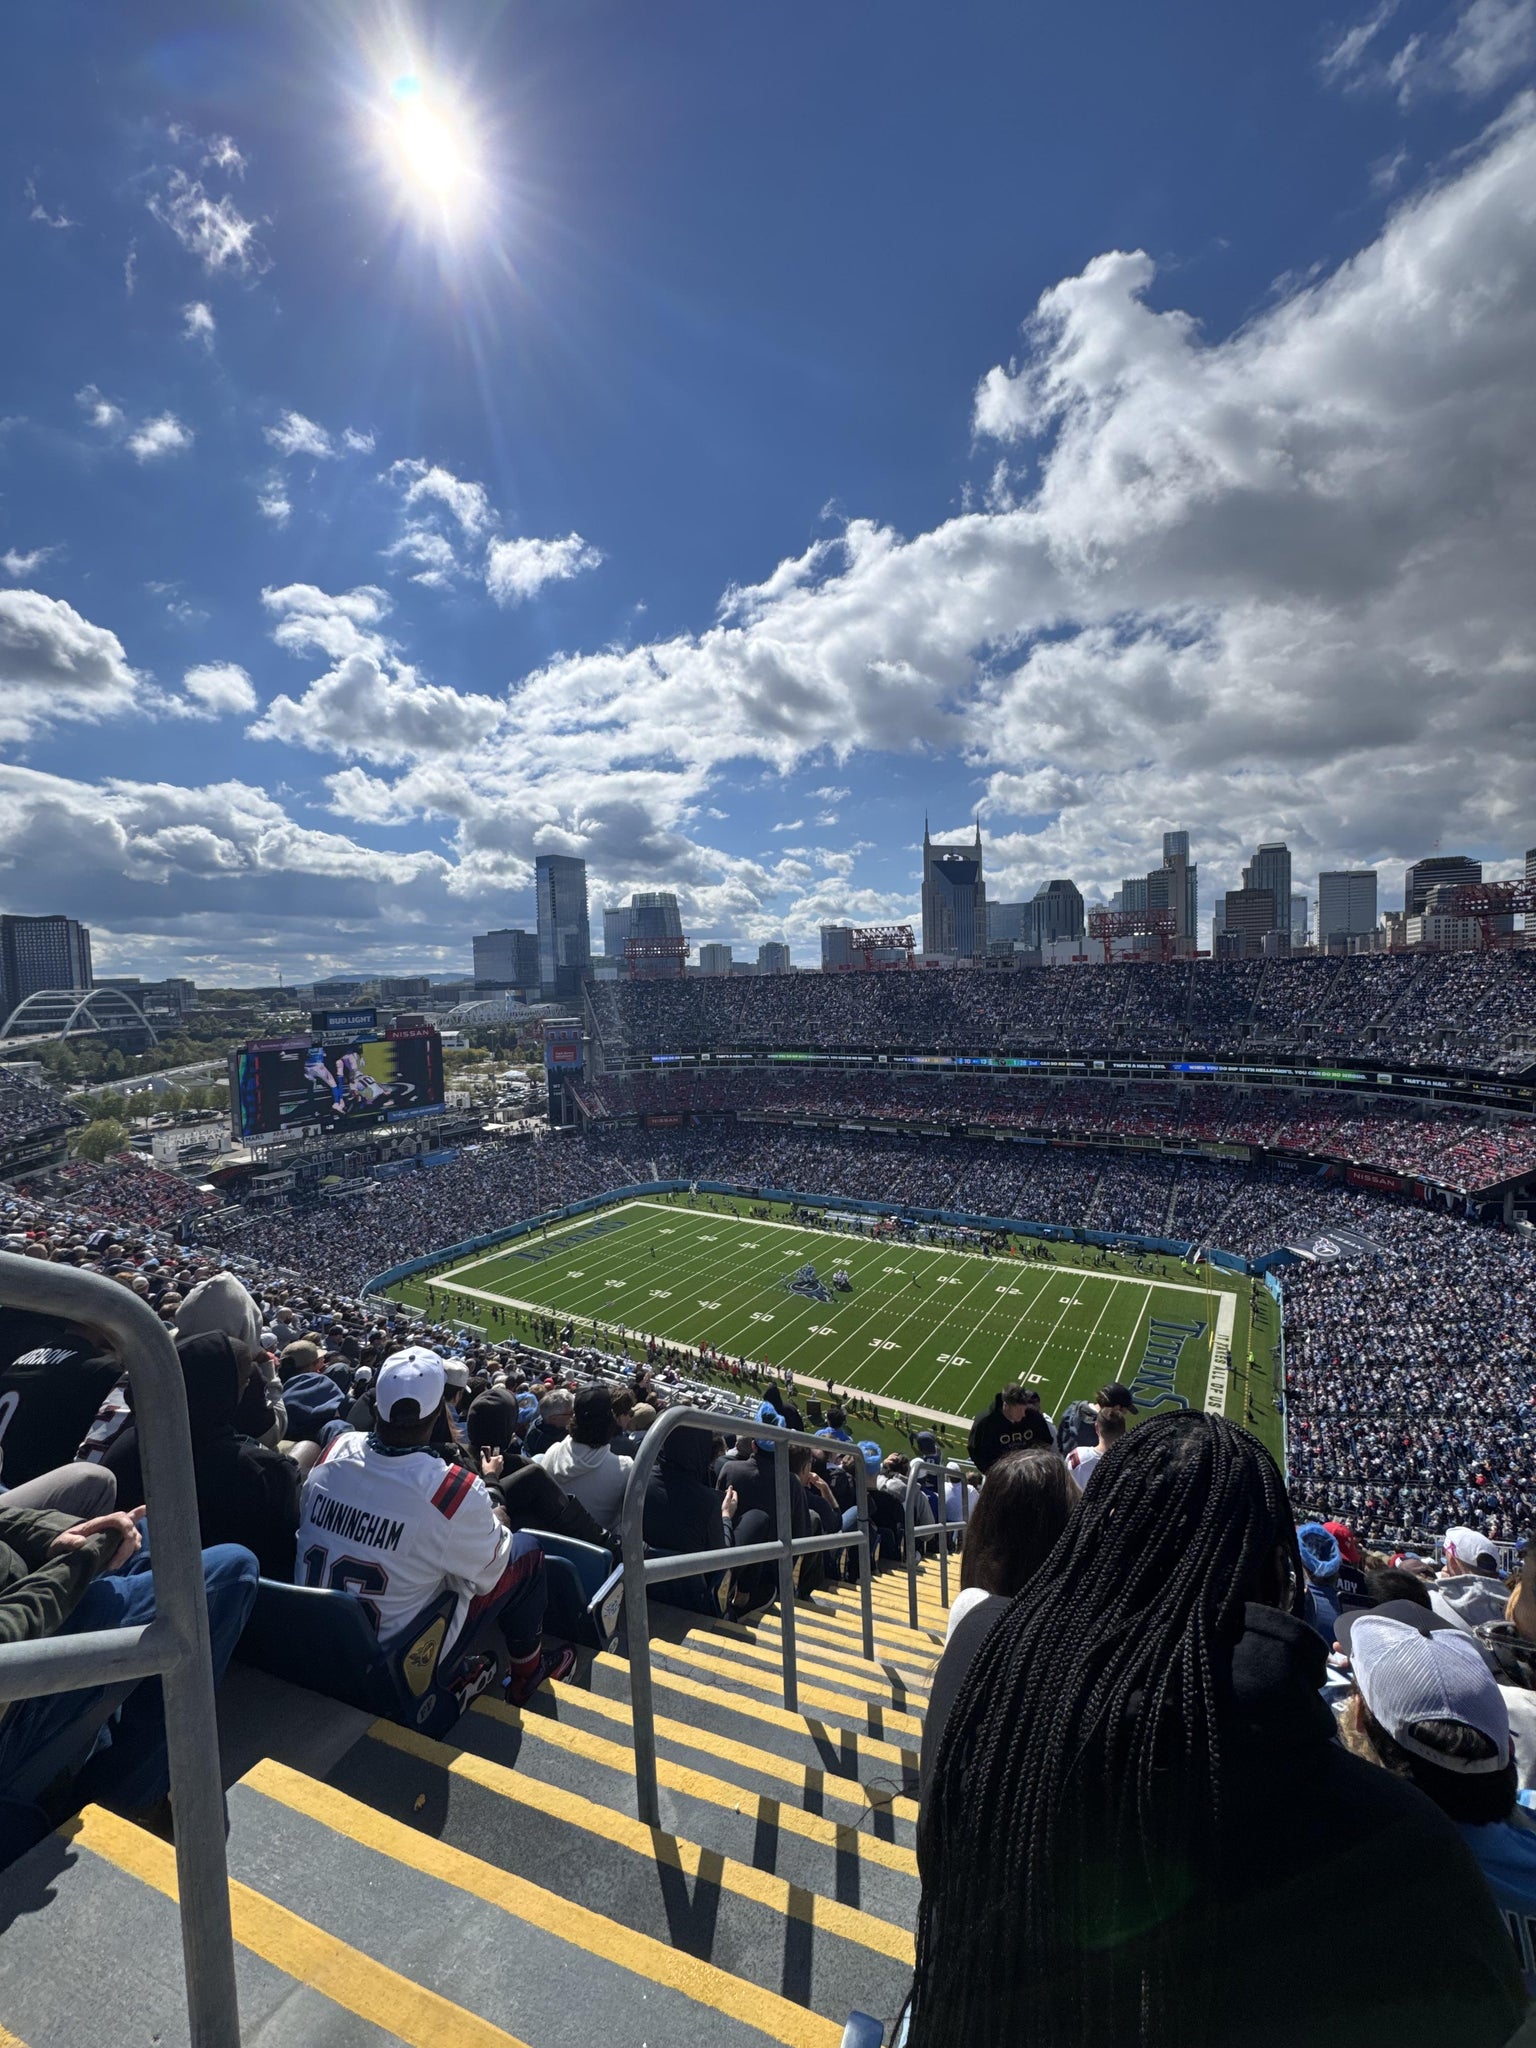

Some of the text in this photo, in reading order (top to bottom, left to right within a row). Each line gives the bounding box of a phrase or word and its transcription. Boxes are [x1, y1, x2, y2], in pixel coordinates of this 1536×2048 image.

[329, 1016, 371, 1025] BUD LIGHT
[392, 1029, 429, 1038] NISSAN
[177, 1132, 223, 1145] NISSAN
[1353, 1171, 1395, 1187] NISSAN
[650, 1289, 673, 1299] 30
[700, 1300, 722, 1310] 40
[749, 1311, 775, 1322] 50
[807, 1325, 833, 1336] 40
[1217, 1333, 1230, 1341] IT
[868, 1338, 897, 1350] 30
[936, 1353, 967, 1367] 20
[1128, 1316, 1208, 1410] TITANS
[1017, 1371, 1043, 1384] 10
[1212, 1366, 1226, 1379] ALL
[1210, 1382, 1224, 1394] OF
[1208, 1395, 1222, 1408] US
[310, 1494, 405, 1551] CUNNINGHAM
